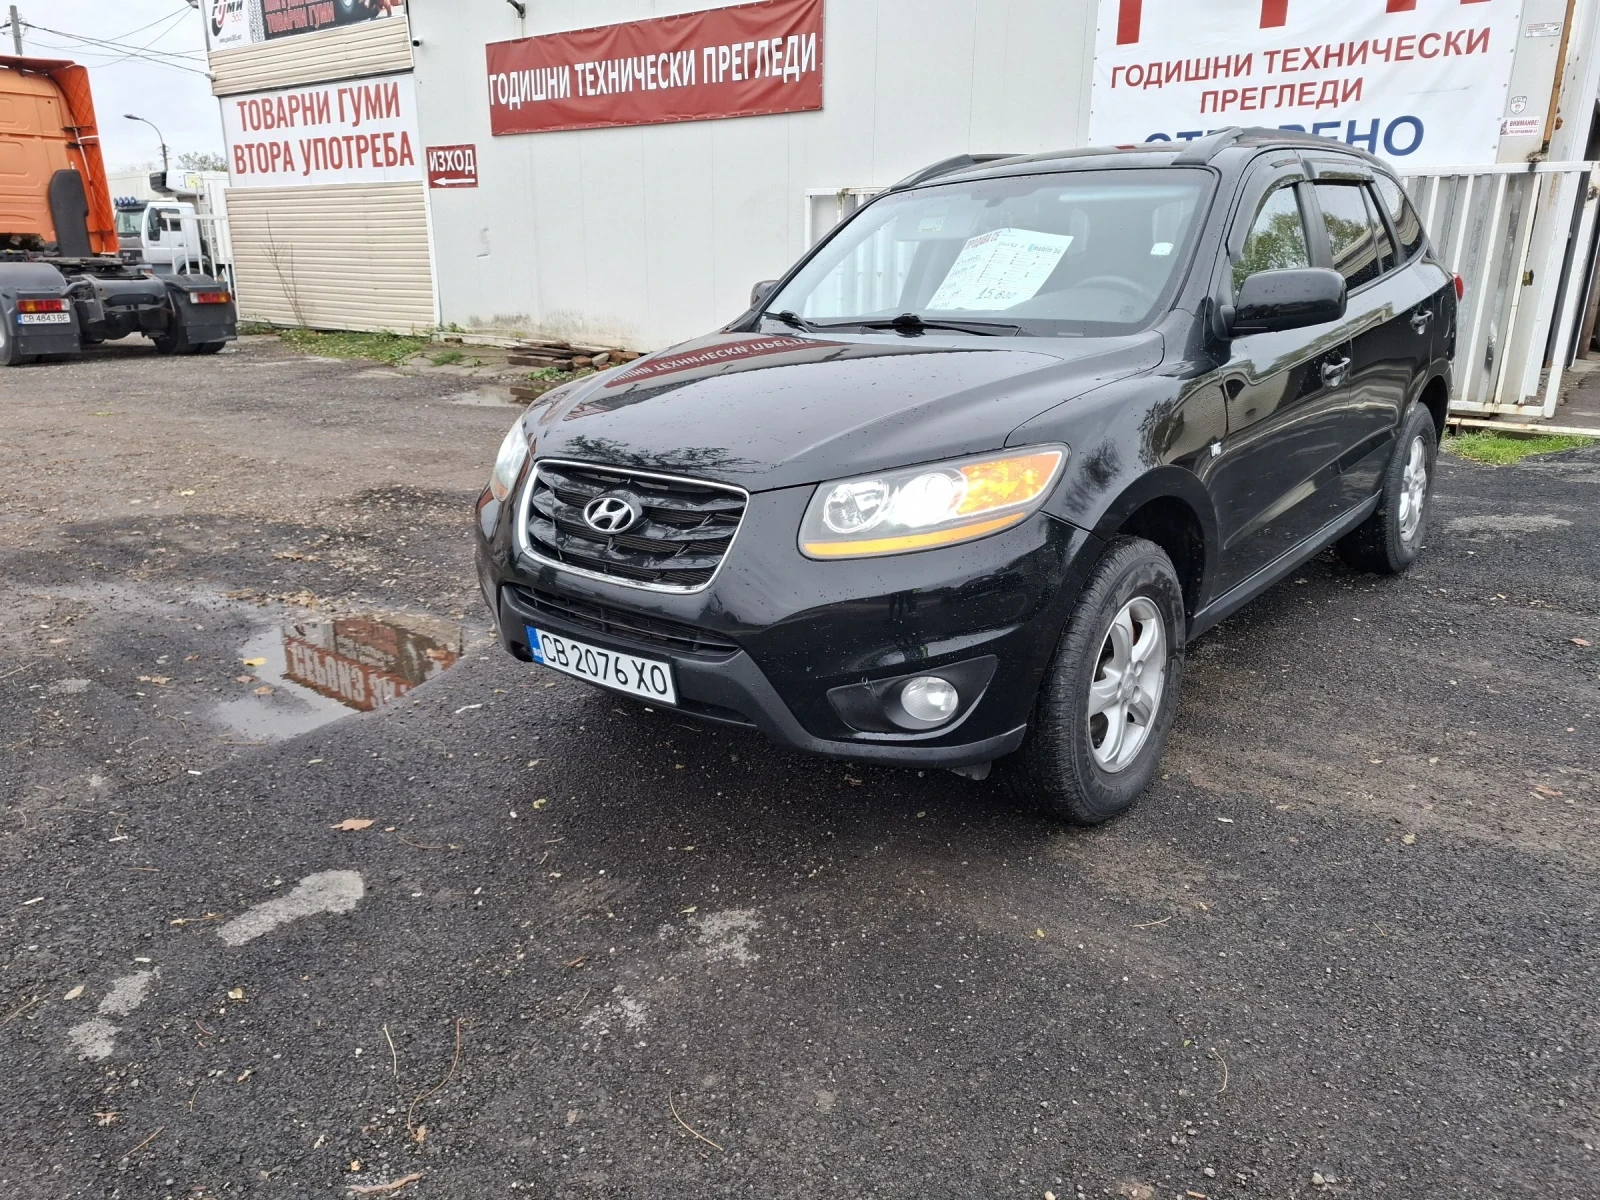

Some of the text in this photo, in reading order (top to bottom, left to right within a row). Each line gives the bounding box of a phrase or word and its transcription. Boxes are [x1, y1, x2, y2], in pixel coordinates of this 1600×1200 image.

[266, 7, 307, 33] ТОВАРНИ
[489, 32, 817, 111] ГОДИШНИ ТЕХНИЧЕСКИ ПРЕГЛЕДИ
[1111, 27, 1491, 91] ГОДИШНИ ТЕХНИЧЕСКИ
[237, 82, 400, 132] ТОВАРНИ ГУМИ
[1199, 78, 1363, 114] ПРЕГЛЕДИ
[233, 130, 415, 176] ВТОРА УПОТРЕБА
[428, 149, 475, 177] ИЗХОД
